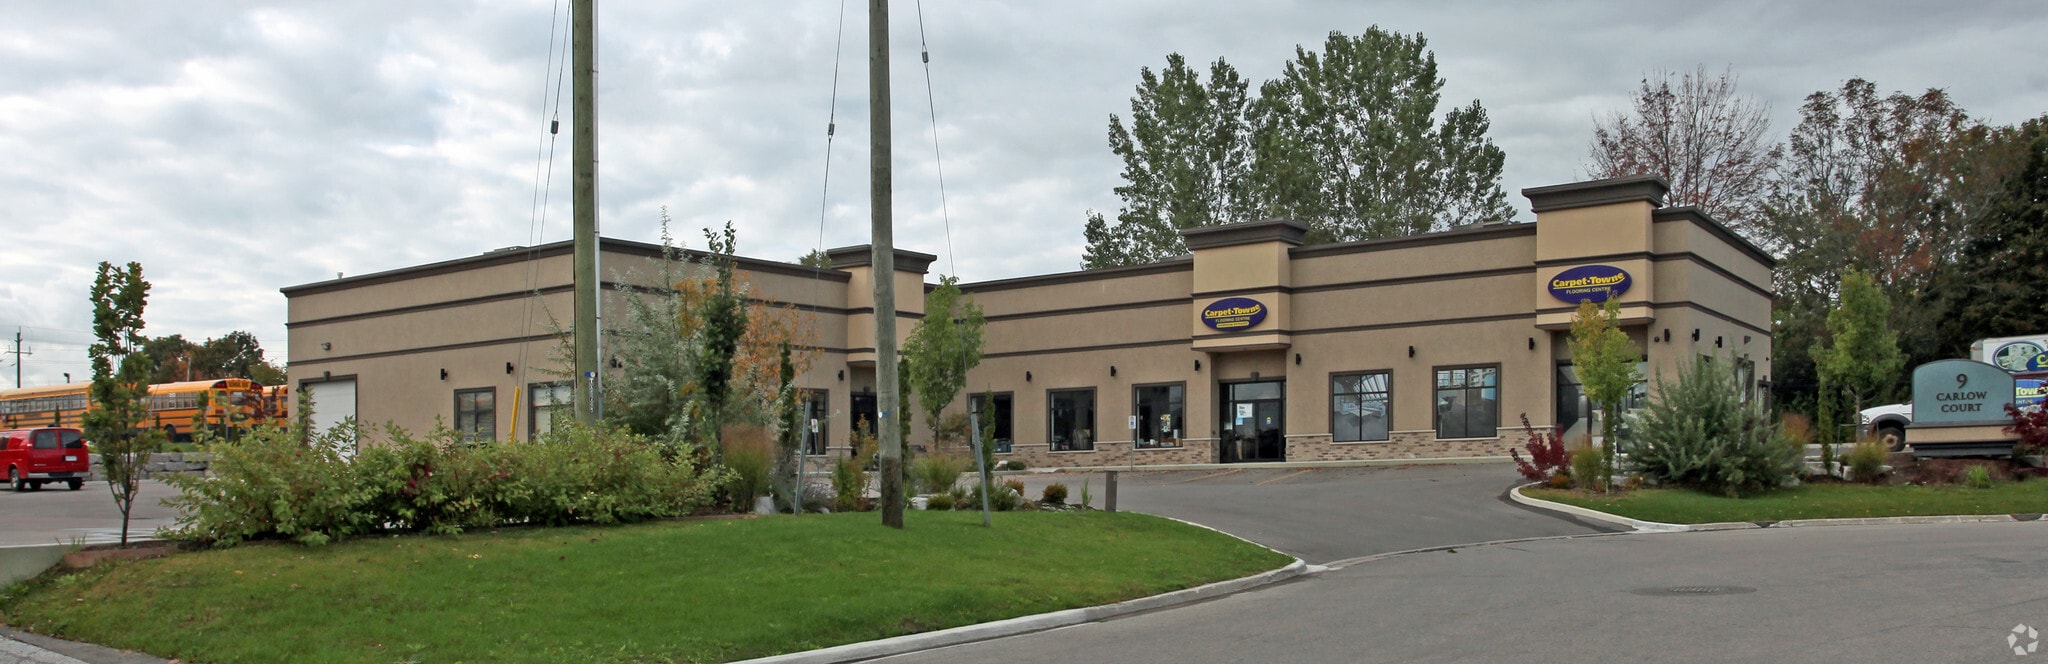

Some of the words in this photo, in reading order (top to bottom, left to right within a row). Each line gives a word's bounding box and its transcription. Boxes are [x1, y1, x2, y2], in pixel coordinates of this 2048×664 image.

[1956, 373, 1968, 389] 9
[1936, 392, 1987, 401] CARLOW
[1941, 403, 1982, 413] COURT
